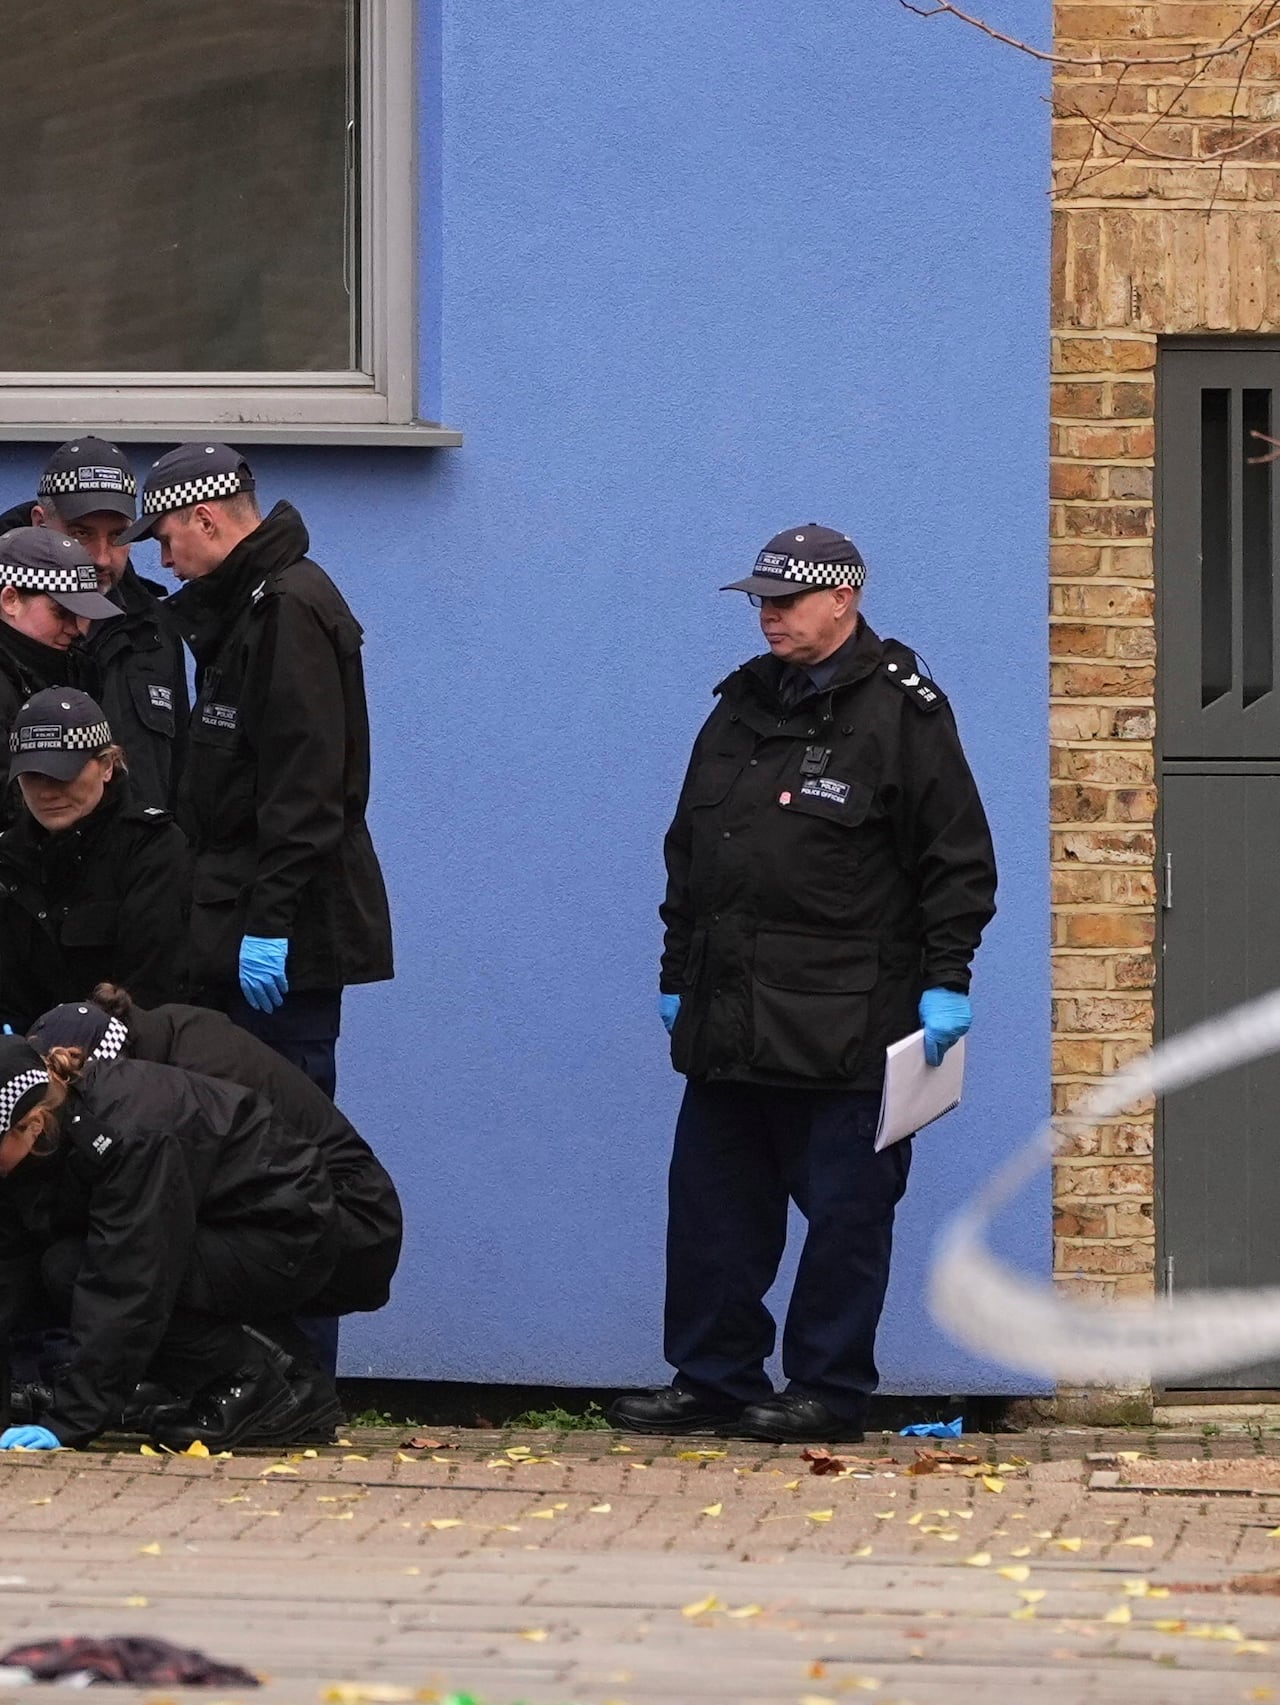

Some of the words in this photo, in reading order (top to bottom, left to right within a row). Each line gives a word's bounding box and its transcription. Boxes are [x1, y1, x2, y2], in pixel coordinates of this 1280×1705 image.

[80, 481, 100, 489] POLICE
[100, 481, 122, 490] OFFICER
[20, 741, 37, 750] POLICE
[37, 741, 61, 749] OFFICER
[821, 783, 840, 793] POLICE
[801, 787, 820, 796] POLICE
[820, 791, 845, 804] OFFICER
